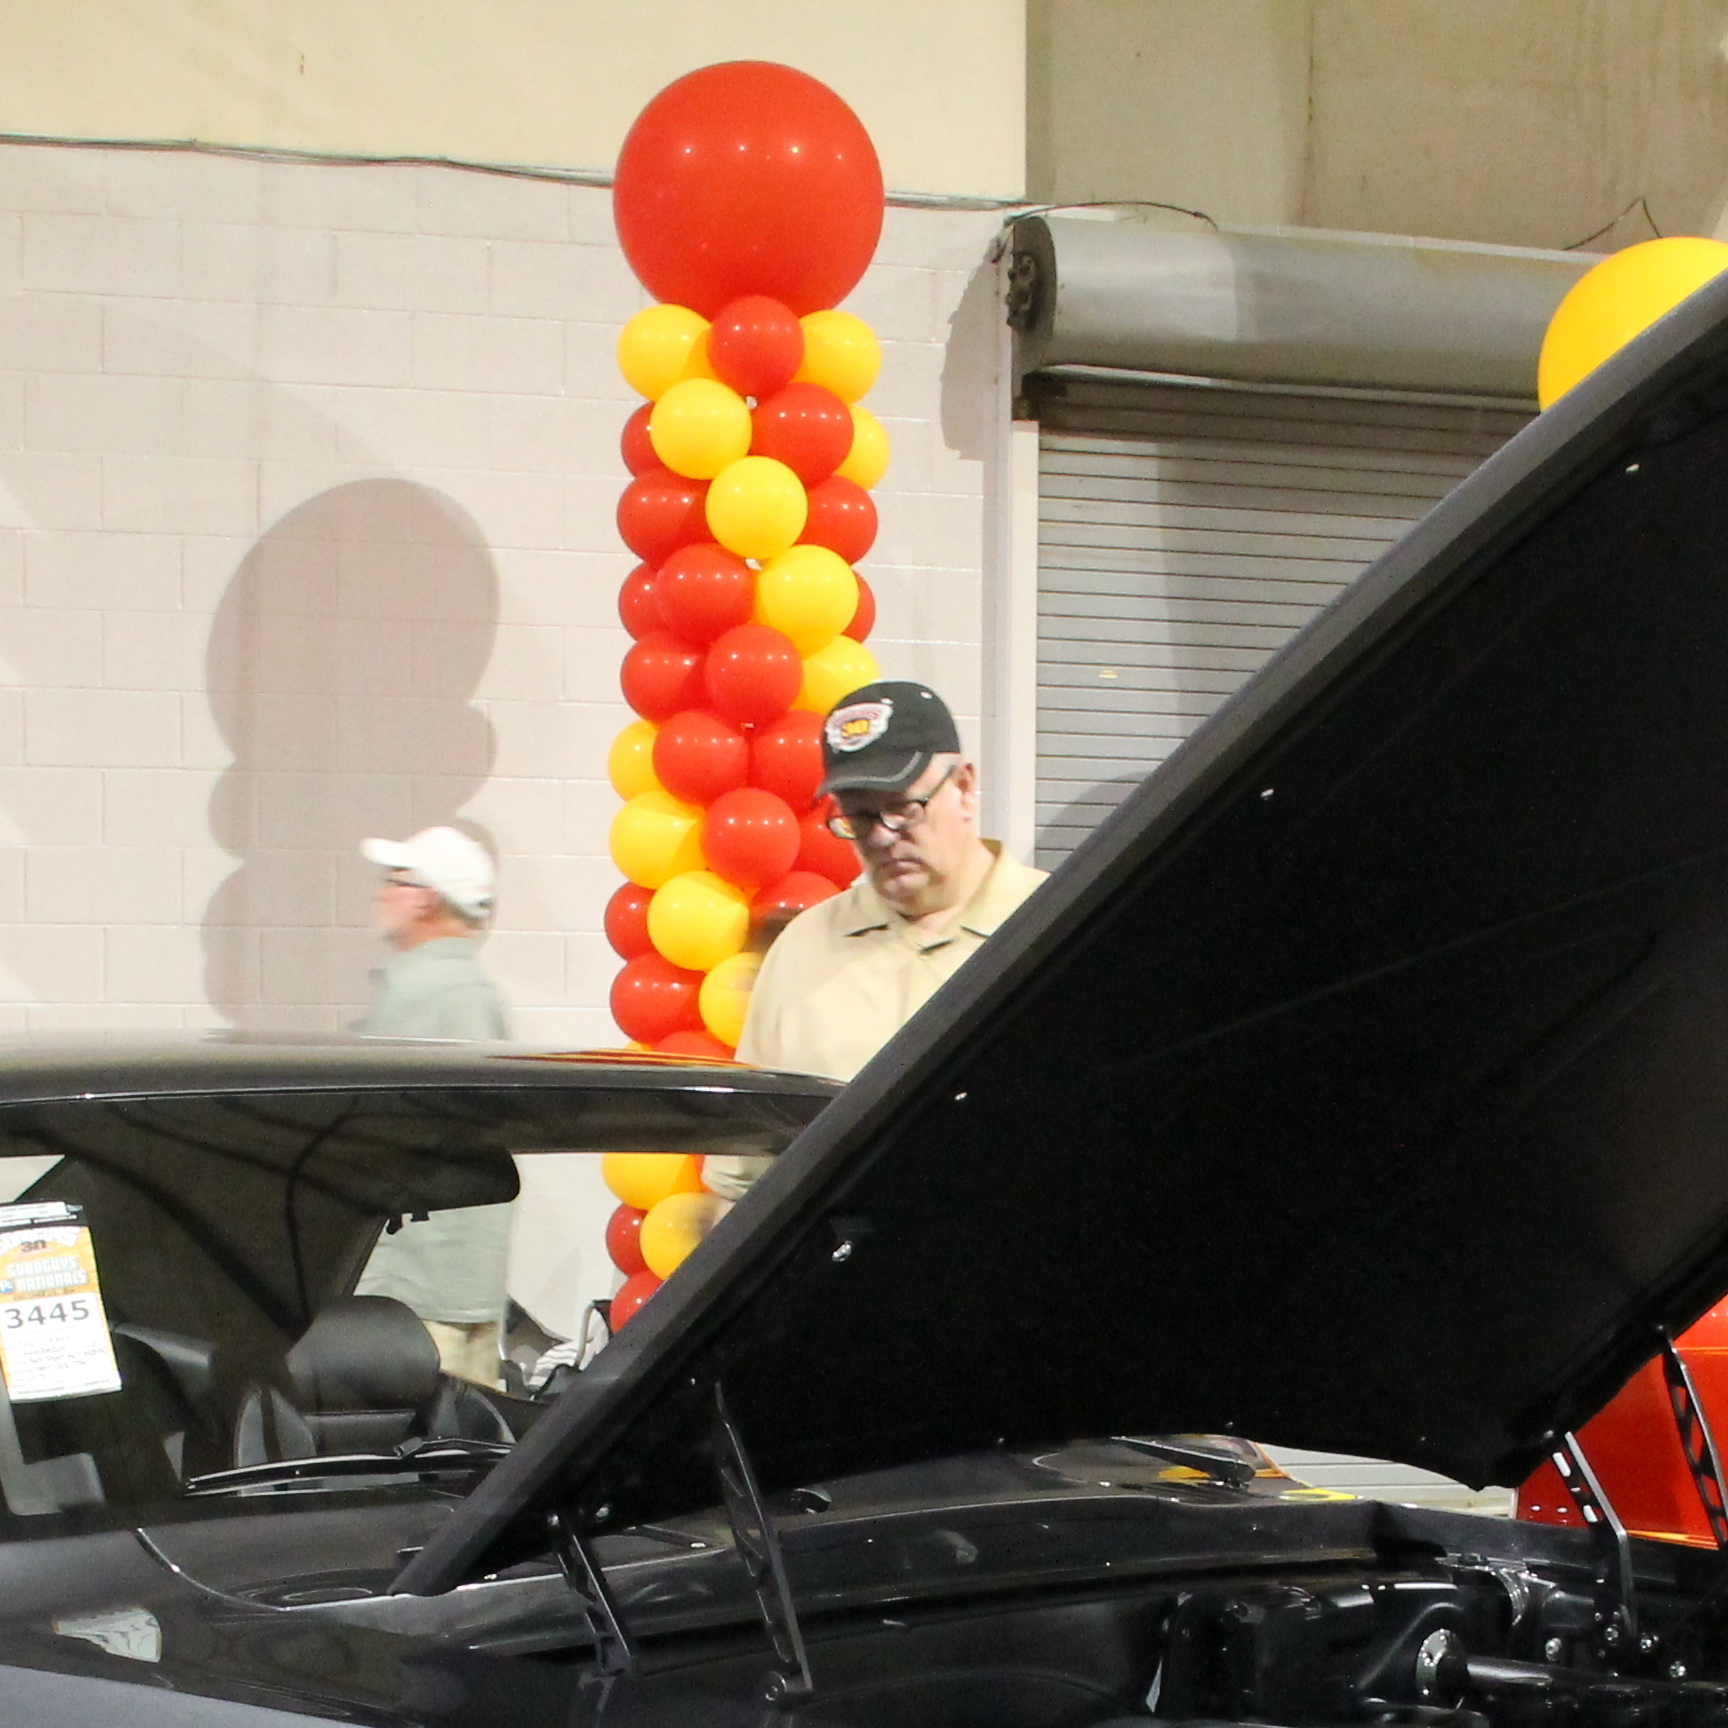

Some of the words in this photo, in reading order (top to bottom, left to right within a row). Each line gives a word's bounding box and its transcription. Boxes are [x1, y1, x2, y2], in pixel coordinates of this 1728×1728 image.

[6, 1256, 78, 1278] GOODGUYS
[17, 1270, 89, 1292] NATIONALS
[4, 1299, 90, 1330] 3445
